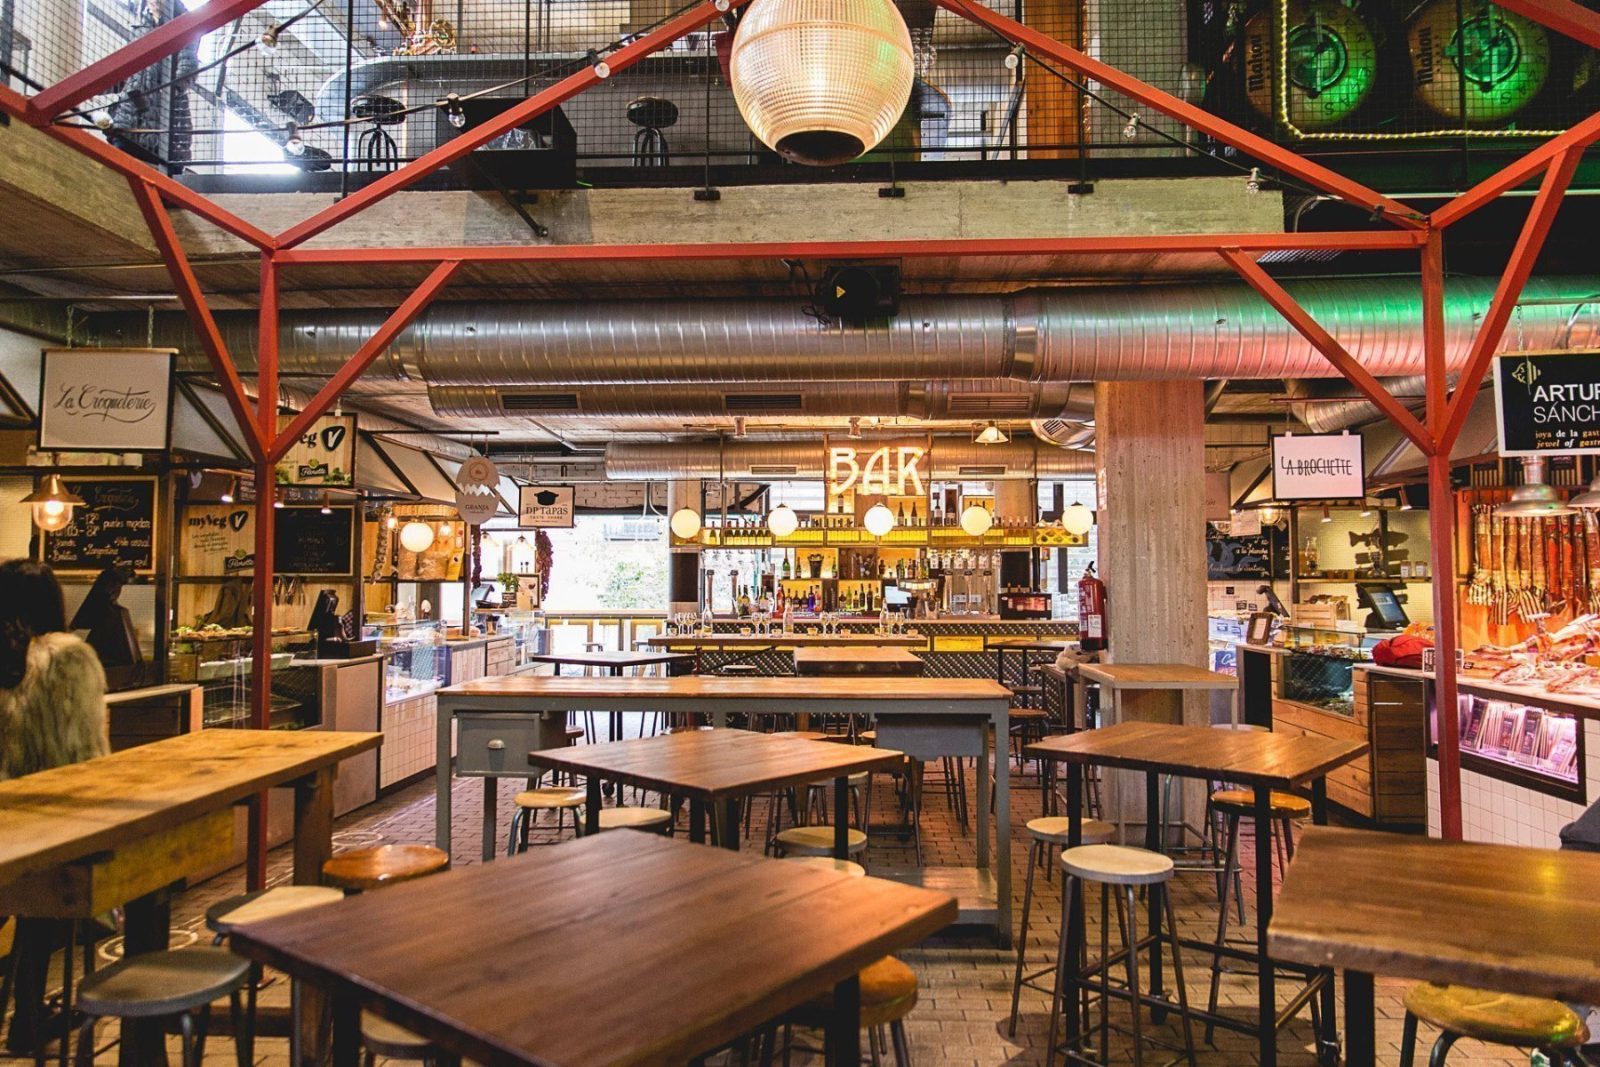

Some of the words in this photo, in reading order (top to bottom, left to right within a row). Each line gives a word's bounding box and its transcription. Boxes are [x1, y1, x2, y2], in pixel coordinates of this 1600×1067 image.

[1248, 34, 1264, 92] Mahou
[1416, 27, 1433, 86] Mahou
[53, 383, 78, 412] La
[1533, 401, 1600, 423] SÁNCH
[1536, 439, 1560, 449] jewel
[1564, 438, 1575, 448] of
[1556, 429, 1566, 438] de
[1570, 429, 1578, 437] la
[829, 447, 925, 496] BAR
[1281, 456, 1294, 475] LA
[1297, 458, 1353, 476] BROCHETTE
[526, 506, 539, 514] DP
